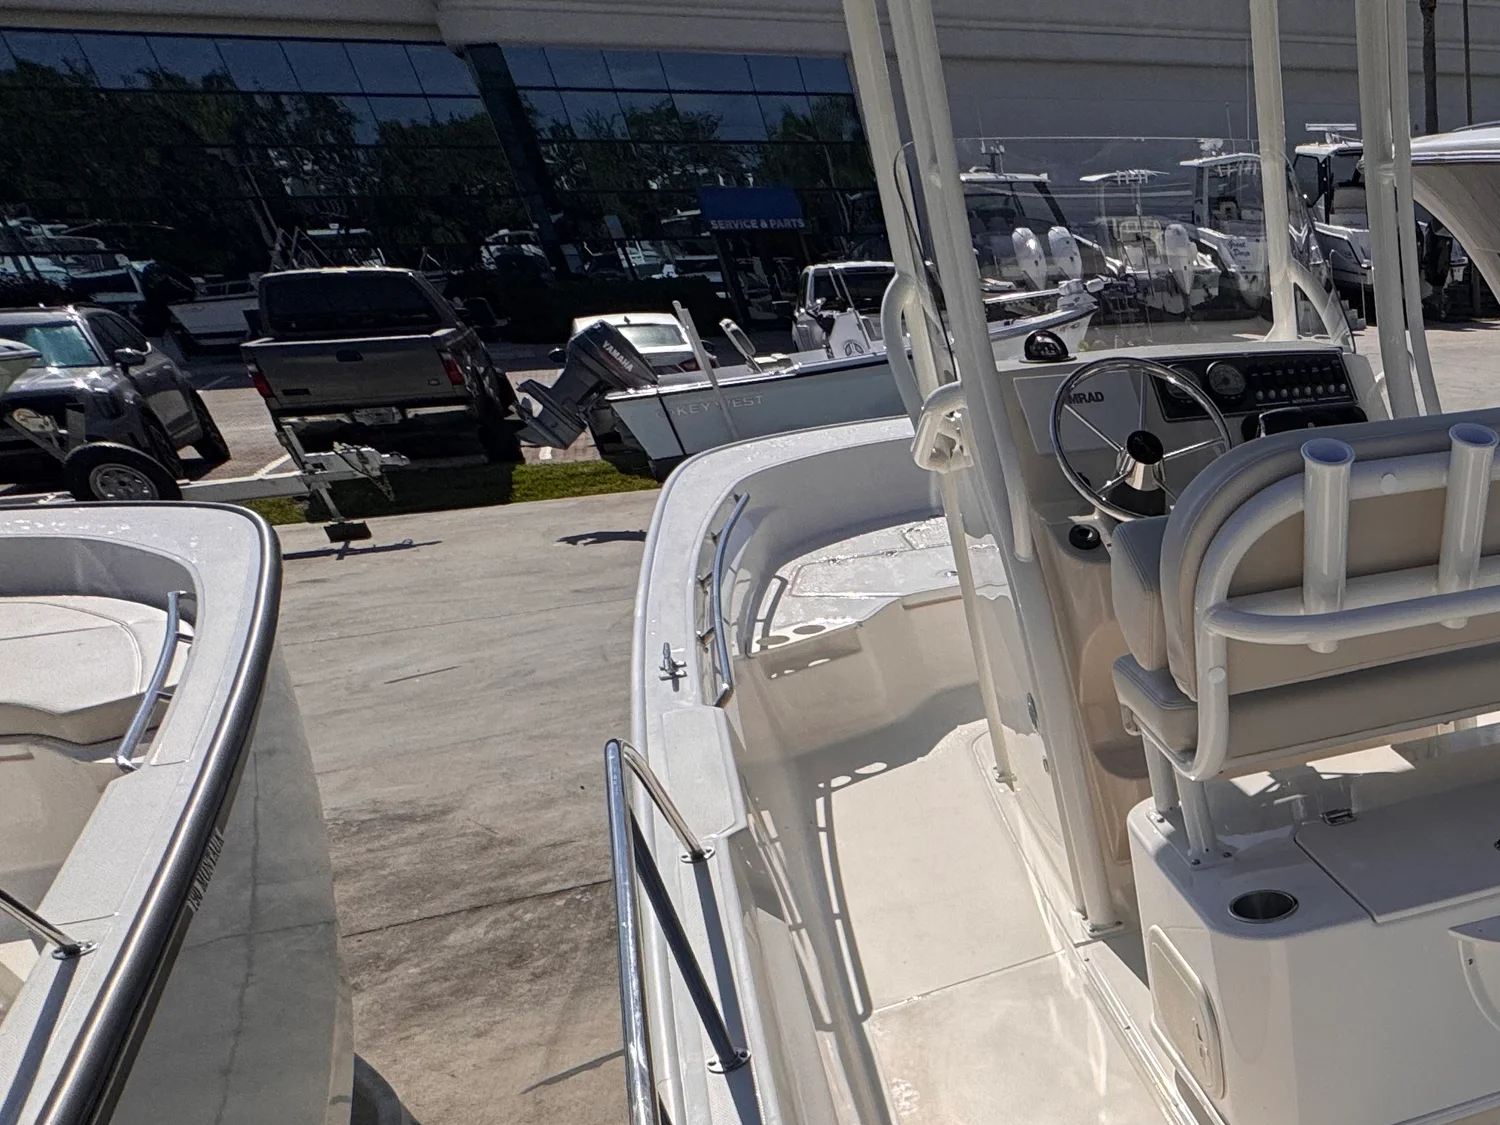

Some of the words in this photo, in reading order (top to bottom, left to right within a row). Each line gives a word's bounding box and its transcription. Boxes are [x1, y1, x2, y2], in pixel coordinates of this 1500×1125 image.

[711, 219, 758, 230] SERVICE
[760, 219, 768, 229] &
[769, 218, 805, 229] PARTS
[603, 340, 634, 373] YAMAHA
[1068, 391, 1105, 404] MRAD
[677, 402, 711, 416] KEY
